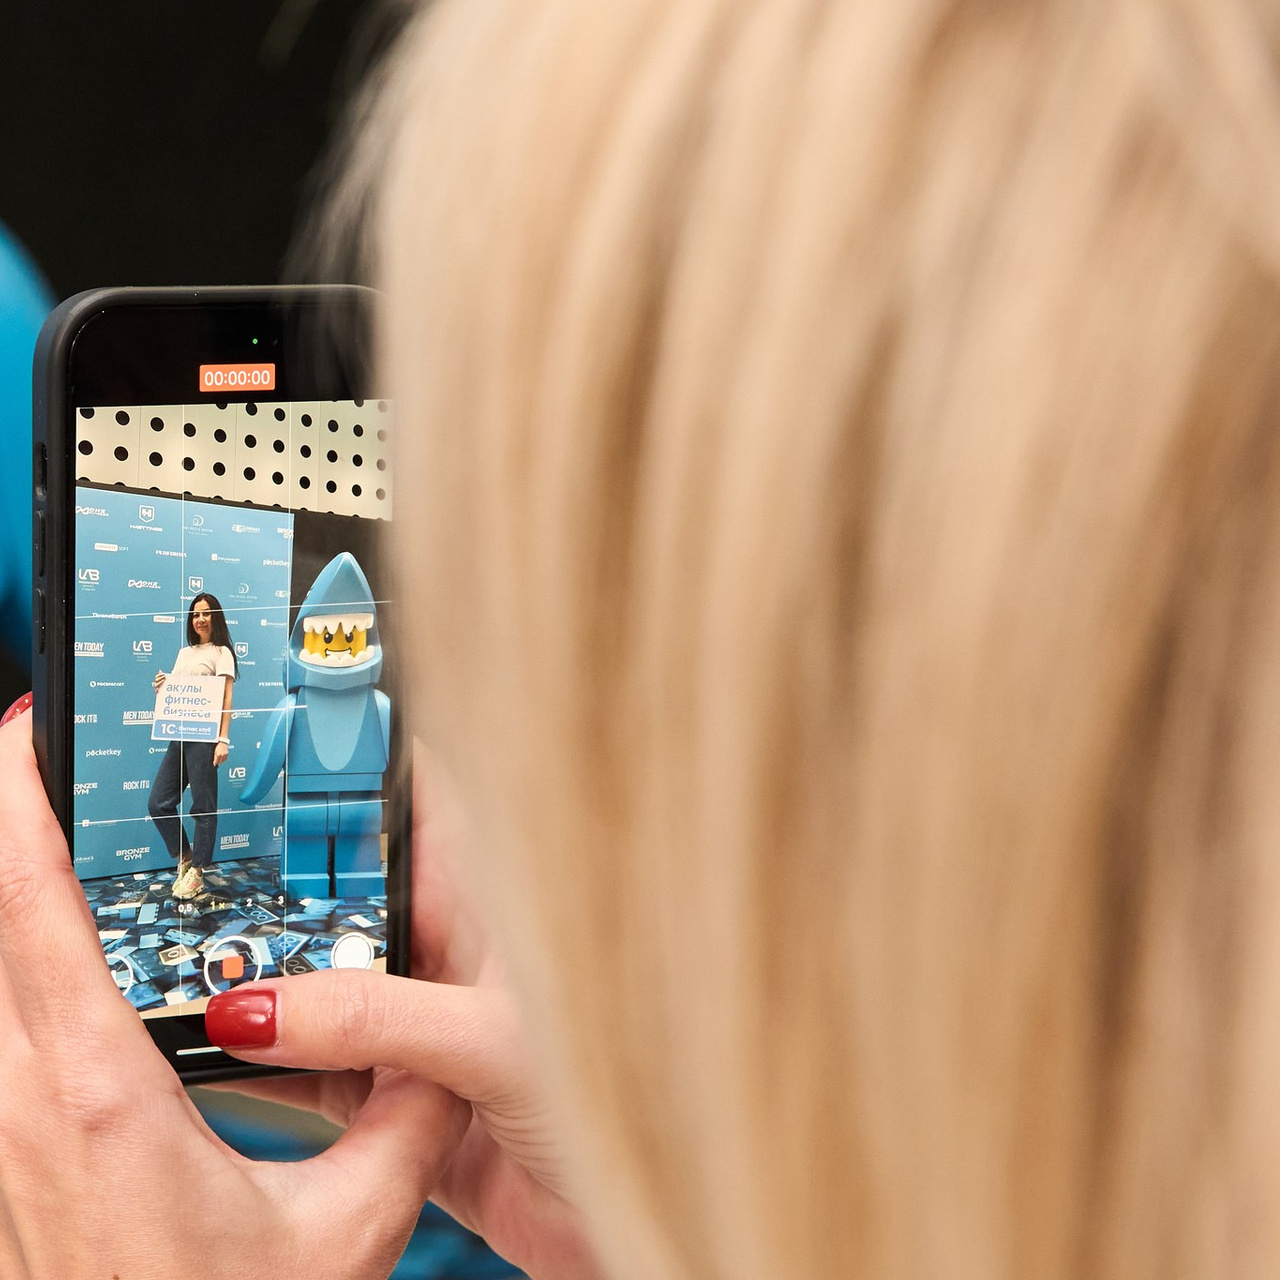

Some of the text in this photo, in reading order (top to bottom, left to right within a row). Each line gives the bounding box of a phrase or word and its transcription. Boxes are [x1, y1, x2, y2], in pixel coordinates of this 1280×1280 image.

[204, 370, 270, 386] 00:00:00
[84, 642, 104, 652] TODAY
[166, 684, 202, 694] акулы
[164, 694, 212, 706] фитнес-
[124, 712, 138, 720] MEN
[164, 708, 210, 718] бизнеса
[86, 748, 122, 758] pocketkey
[124, 782, 140, 790] ROCK
[220, 834, 250, 844] MEN TODAY
[116, 847, 150, 856] BRONZE
[246, 898, 252, 906] 2
[278, 896, 284, 904] 3
[178, 904, 192, 914] 0,5
